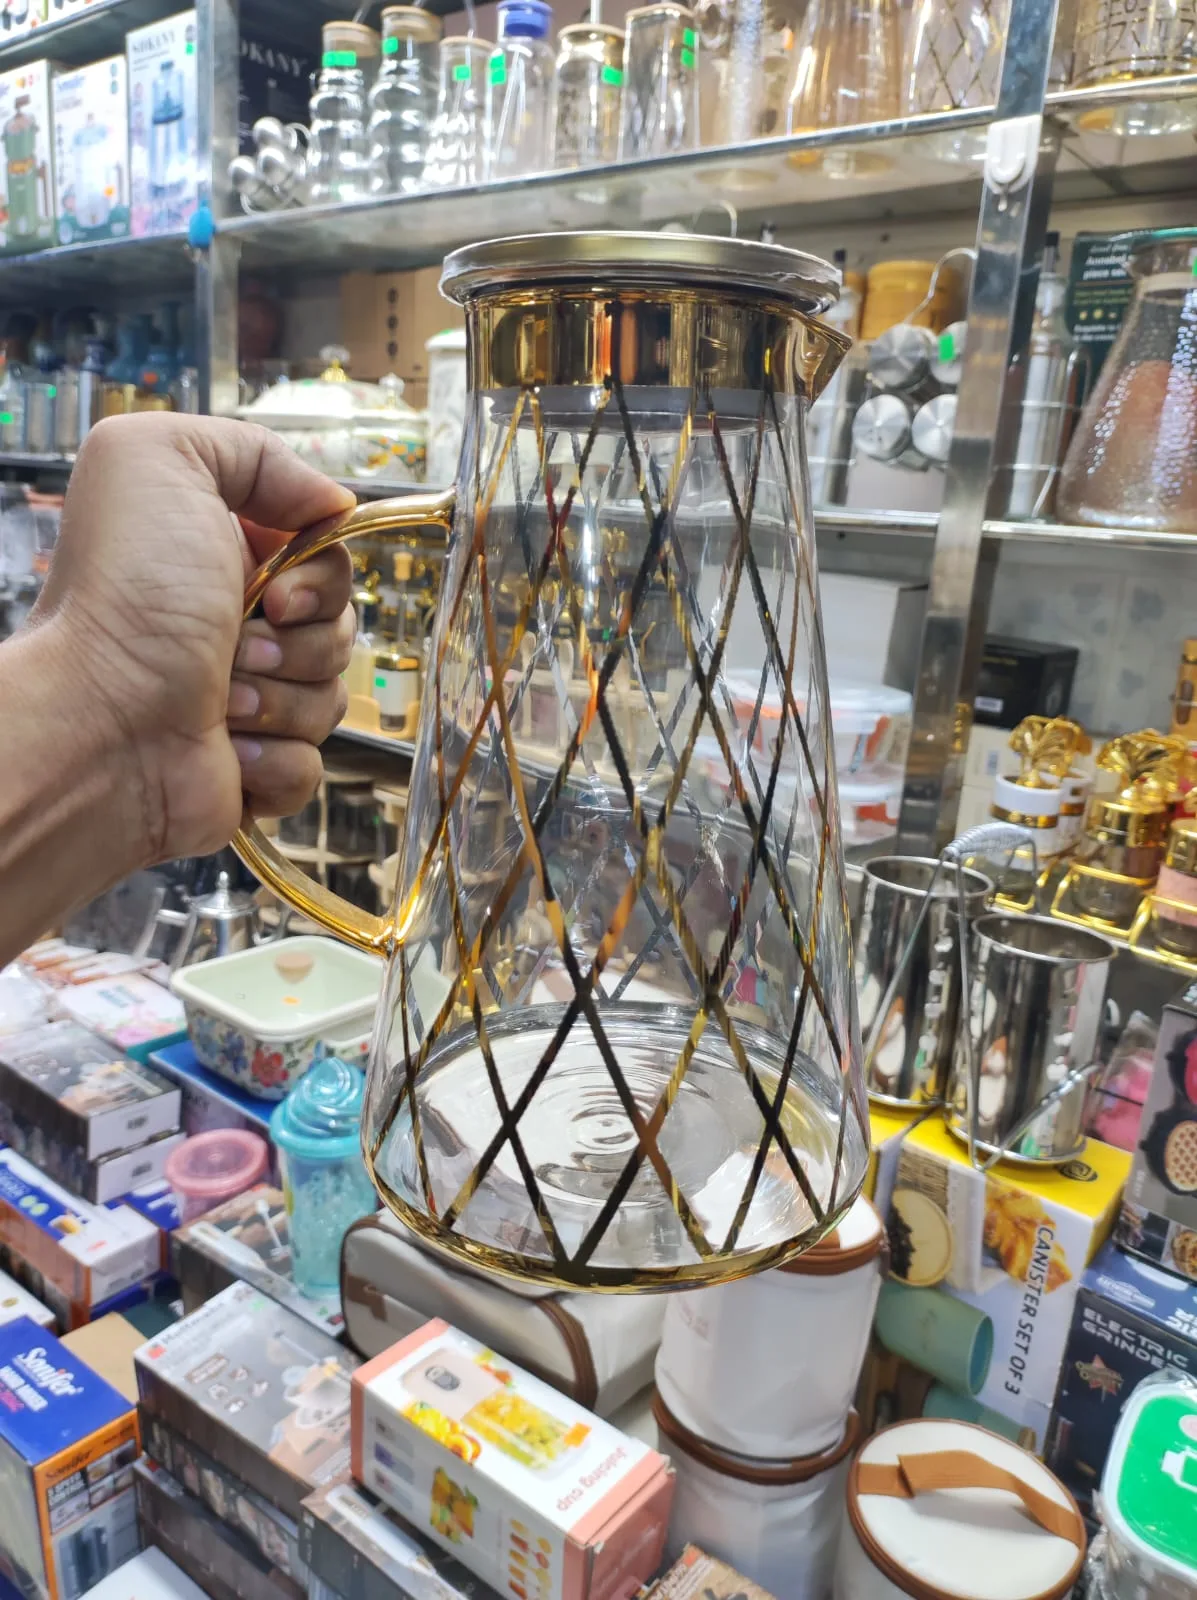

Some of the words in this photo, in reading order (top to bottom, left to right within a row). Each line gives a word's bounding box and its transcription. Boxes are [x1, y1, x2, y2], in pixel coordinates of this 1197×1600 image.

[1021, 1225, 1054, 1318] CANISTER
[1013, 1319, 1034, 1356] SET
[1083, 1307, 1189, 1368] ELECTRIC
[15, 1347, 81, 1396] Sonifer
[1008, 1355, 1026, 1383] OF
[1004, 1381, 1020, 1395] 3
[556, 1488, 584, 1512] cup
